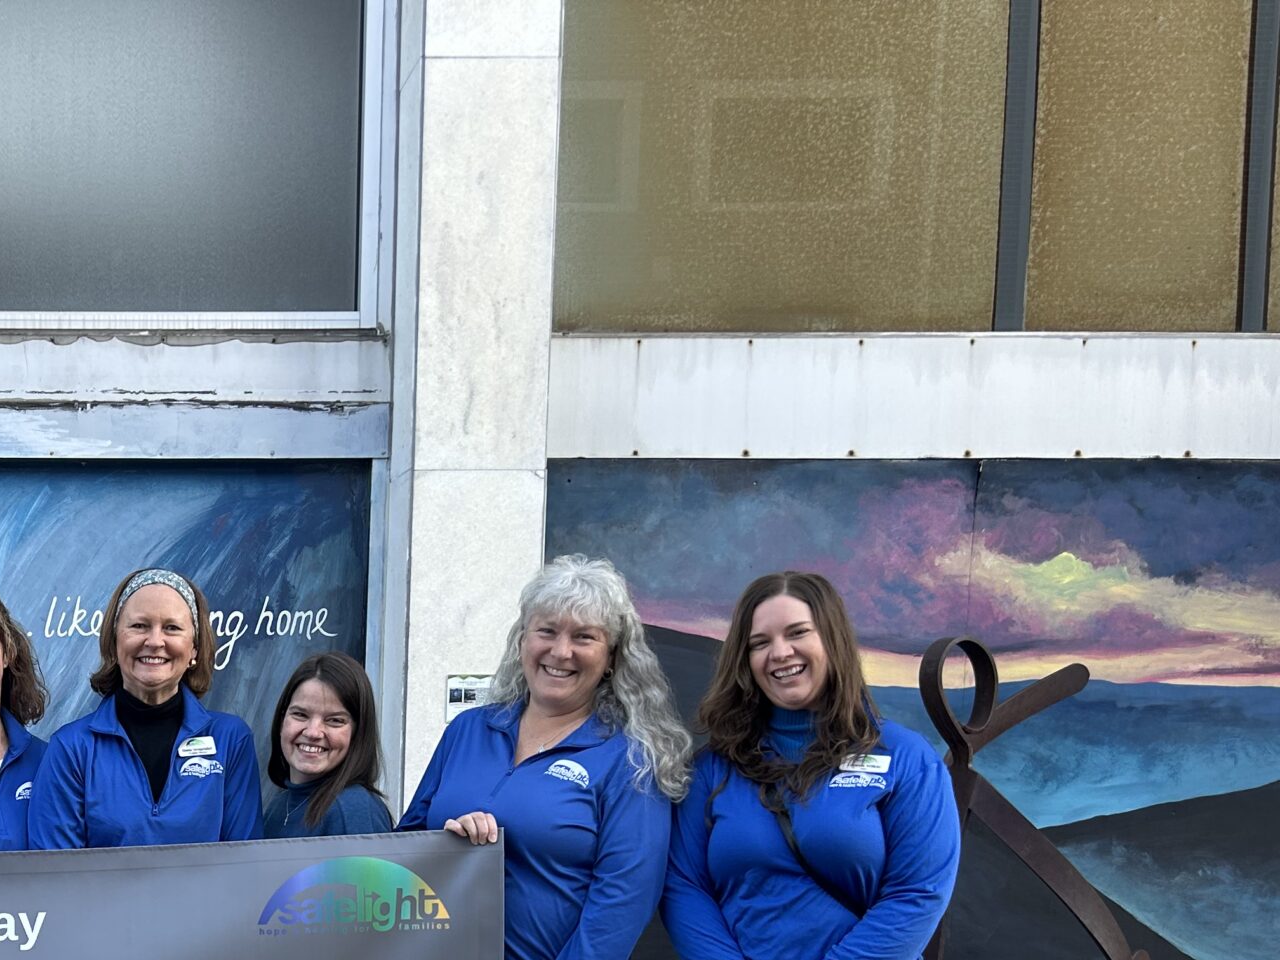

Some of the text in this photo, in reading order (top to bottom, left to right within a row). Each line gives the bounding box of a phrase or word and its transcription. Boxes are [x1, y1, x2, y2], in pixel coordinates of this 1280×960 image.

[44, 595, 102, 638] like
[254, 595, 340, 640] home
[258, 927, 287, 937] hope
[398, 922, 450, 931] families
[278, 886, 440, 932] safelight
